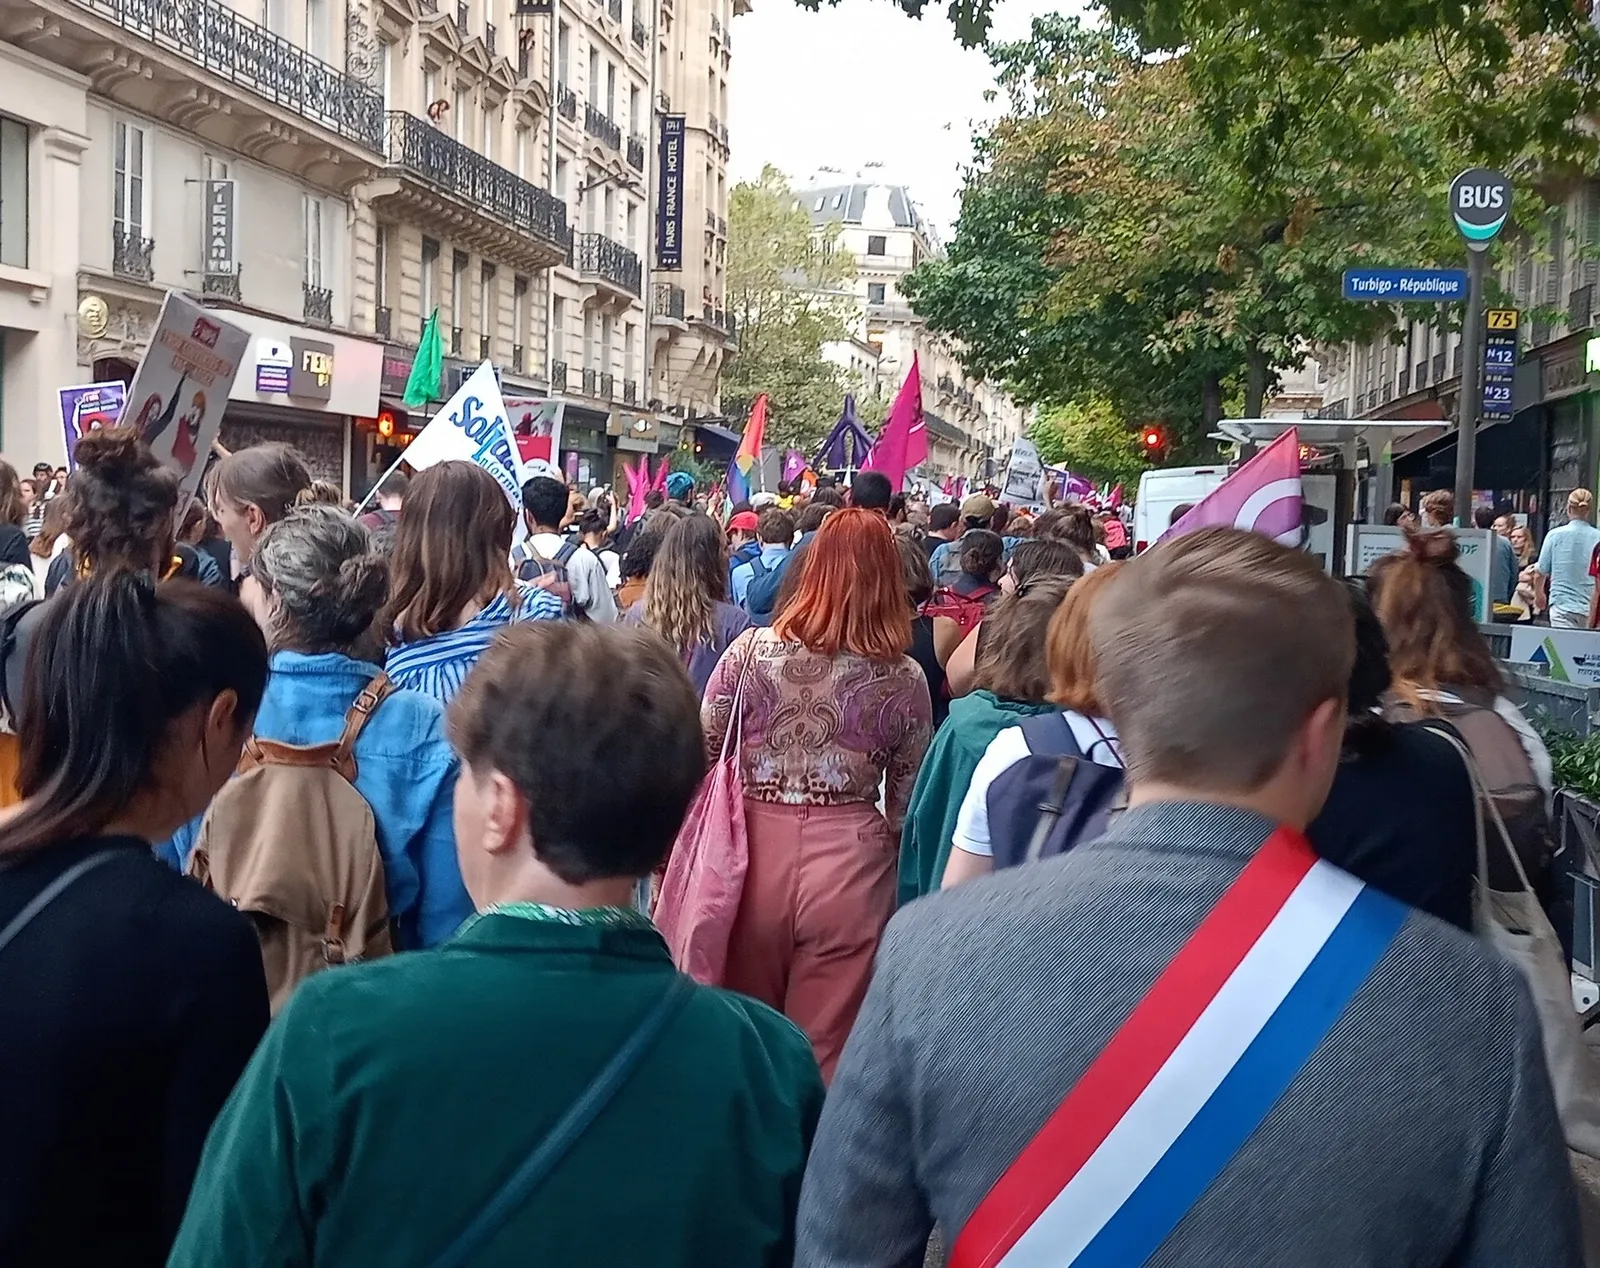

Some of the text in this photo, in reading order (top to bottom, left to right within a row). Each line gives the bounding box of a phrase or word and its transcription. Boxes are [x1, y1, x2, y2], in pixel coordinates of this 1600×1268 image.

[665, 138, 678, 248] PARIS FRANCE HOTEL
[1458, 185, 1504, 209] BUS
[1351, 277, 1391, 294] Turbigo
[1400, 277, 1459, 295] République
[1491, 312, 1513, 328] 75
[1486, 348, 1513, 363] N12
[1484, 385, 1510, 400] N23
